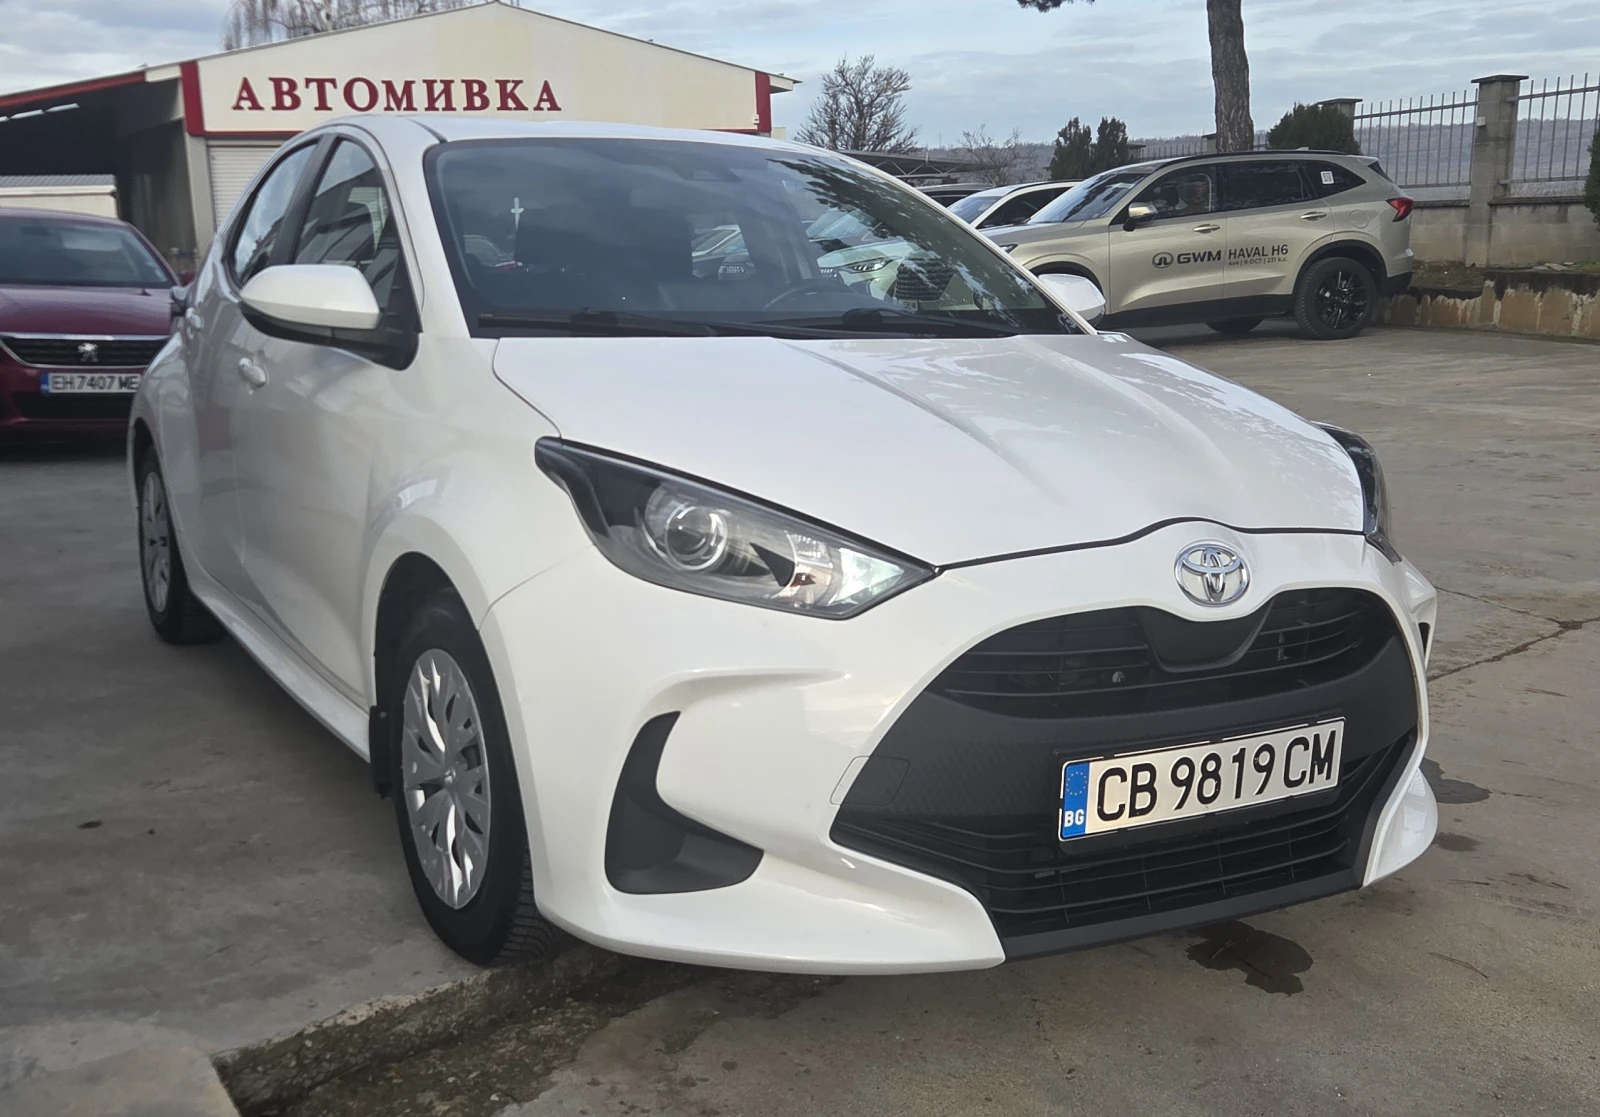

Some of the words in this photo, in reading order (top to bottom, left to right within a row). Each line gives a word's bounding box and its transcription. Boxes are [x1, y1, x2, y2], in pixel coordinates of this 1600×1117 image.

[232, 77, 562, 112] АВТОМИВКА
[1177, 250, 1222, 264] GWM
[1228, 246, 1269, 260] HAVAL
[1271, 244, 1289, 256] H6
[51, 375, 75, 390] EH
[76, 375, 115, 390] 7407
[1097, 763, 1157, 822] CB
[1170, 743, 1276, 811] 9819
[1283, 730, 1337, 789] CM
[1064, 809, 1085, 828] BG
